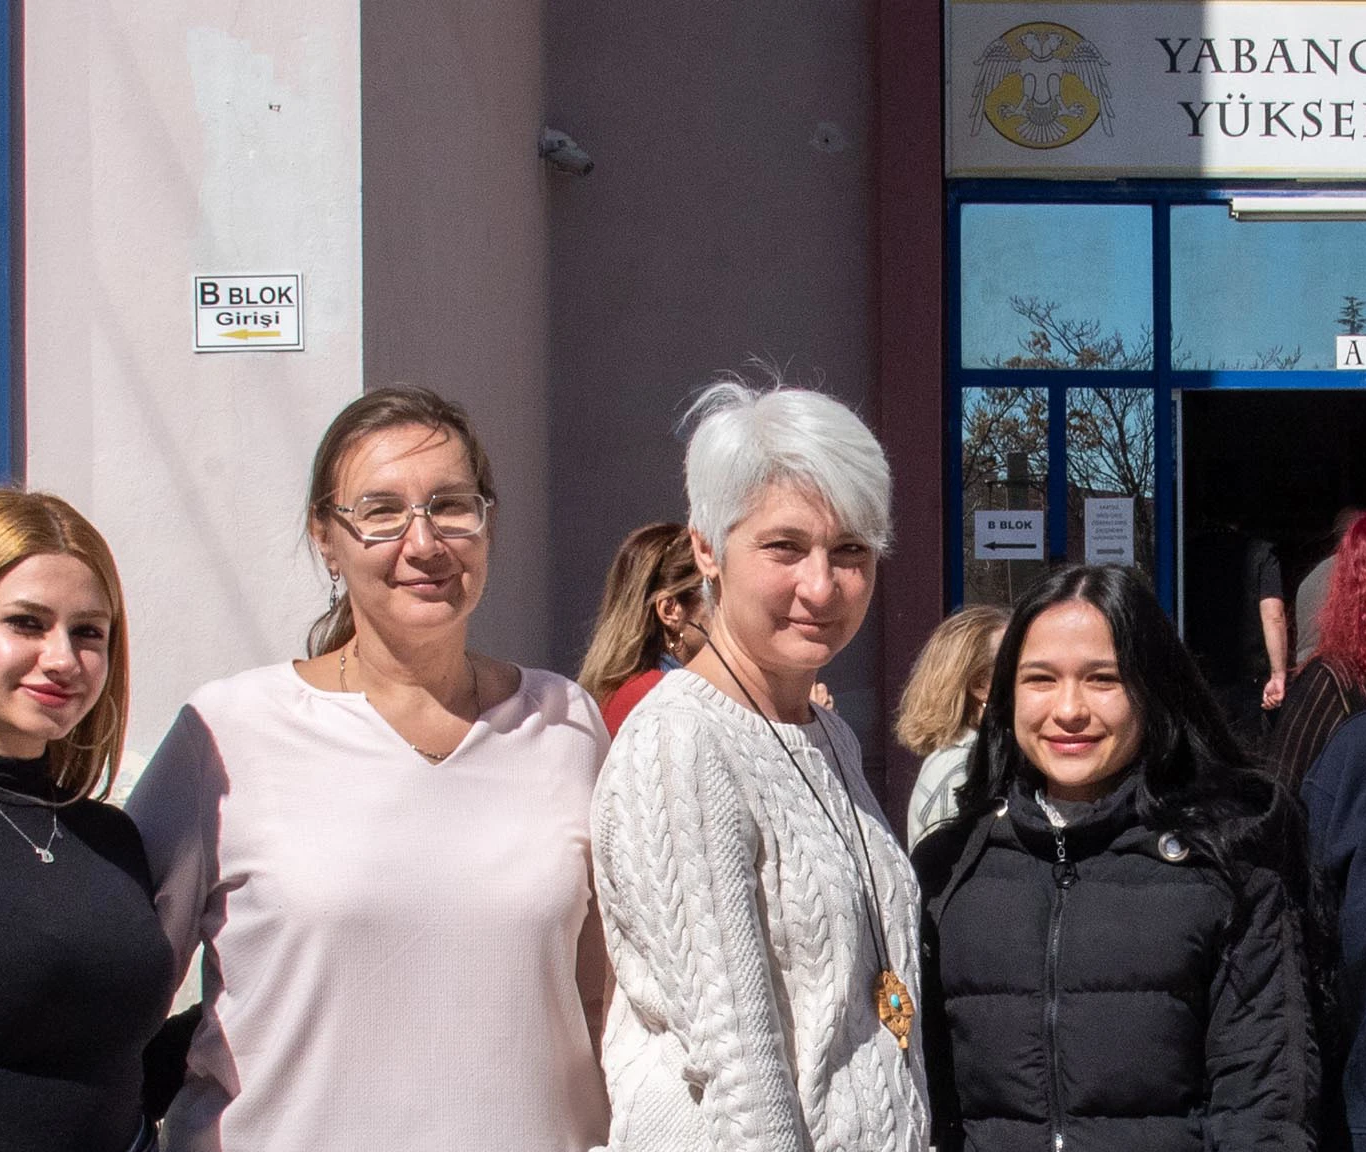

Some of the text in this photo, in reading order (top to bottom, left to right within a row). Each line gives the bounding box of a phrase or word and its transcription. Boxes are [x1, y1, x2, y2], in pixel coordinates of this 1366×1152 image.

[200, 282, 293, 306] B BLOK
[216, 311, 280, 328] Girişi
[1343, 340, 1364, 365] A
[988, 521, 1033, 530] B BLOK
